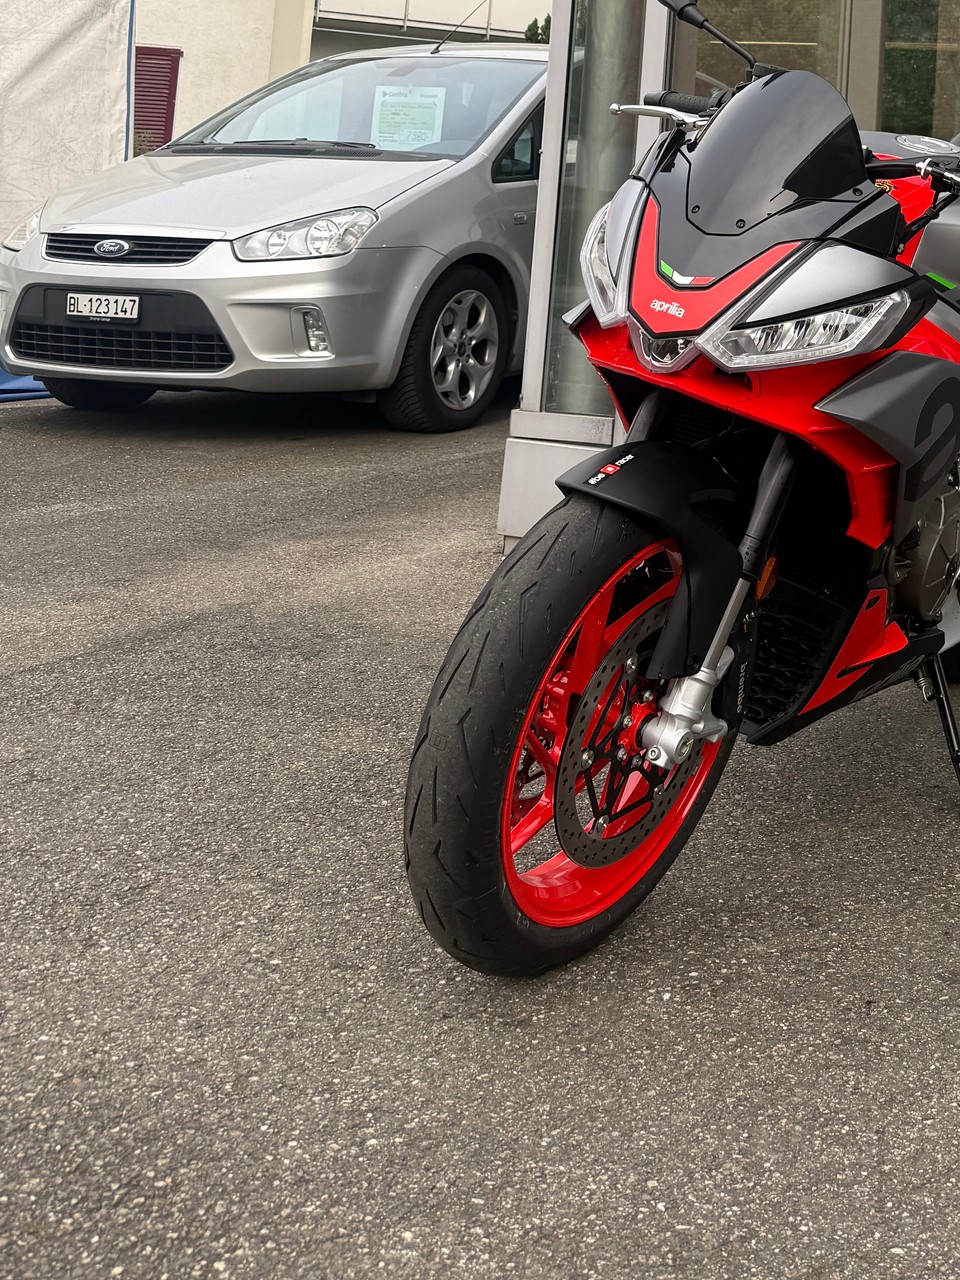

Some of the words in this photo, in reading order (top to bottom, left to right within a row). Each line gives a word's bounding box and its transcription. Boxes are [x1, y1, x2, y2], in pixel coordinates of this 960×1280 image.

[100, 242, 120, 252] Ford
[650, 299, 685, 318] aprilia
[736, 661, 748, 714] brembo
